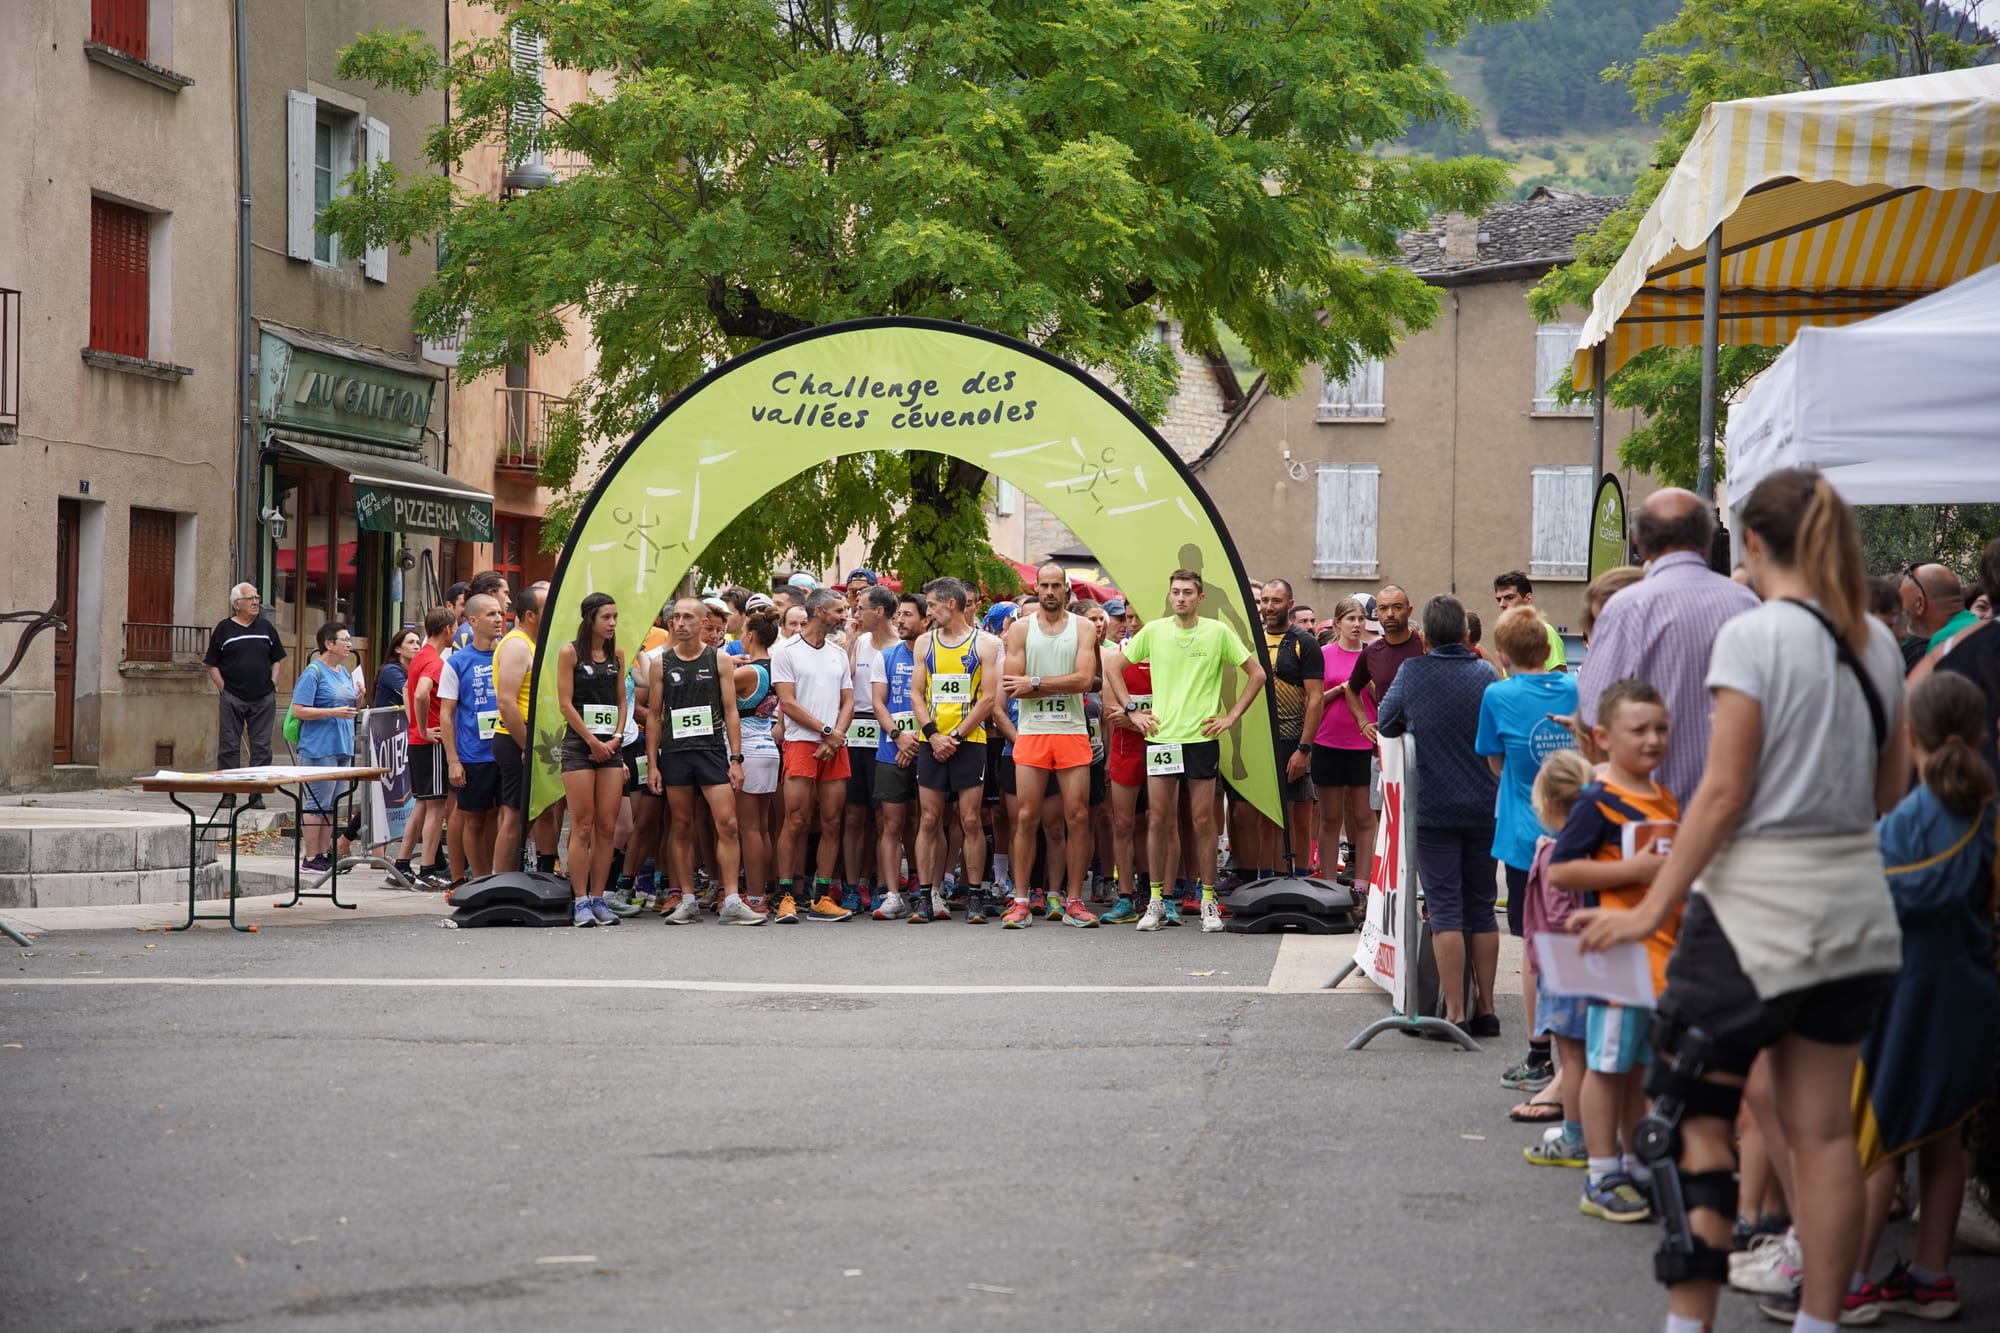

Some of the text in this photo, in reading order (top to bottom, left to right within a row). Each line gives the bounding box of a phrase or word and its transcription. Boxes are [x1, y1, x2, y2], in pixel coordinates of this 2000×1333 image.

[303, 373, 337, 407] AU
[772, 371, 1016, 406] Challenge des
[752, 400, 1037, 428] vallées cévenoles
[356, 491, 377, 514] PIZZA
[394, 497, 460, 531] PIZZERIA
[941, 681, 960, 693] 48
[1036, 700, 1066, 711] 115
[595, 713, 612, 724] 56
[682, 715, 702, 727] 55
[857, 726, 875, 738] 82
[1154, 752, 1172, 764] 43
